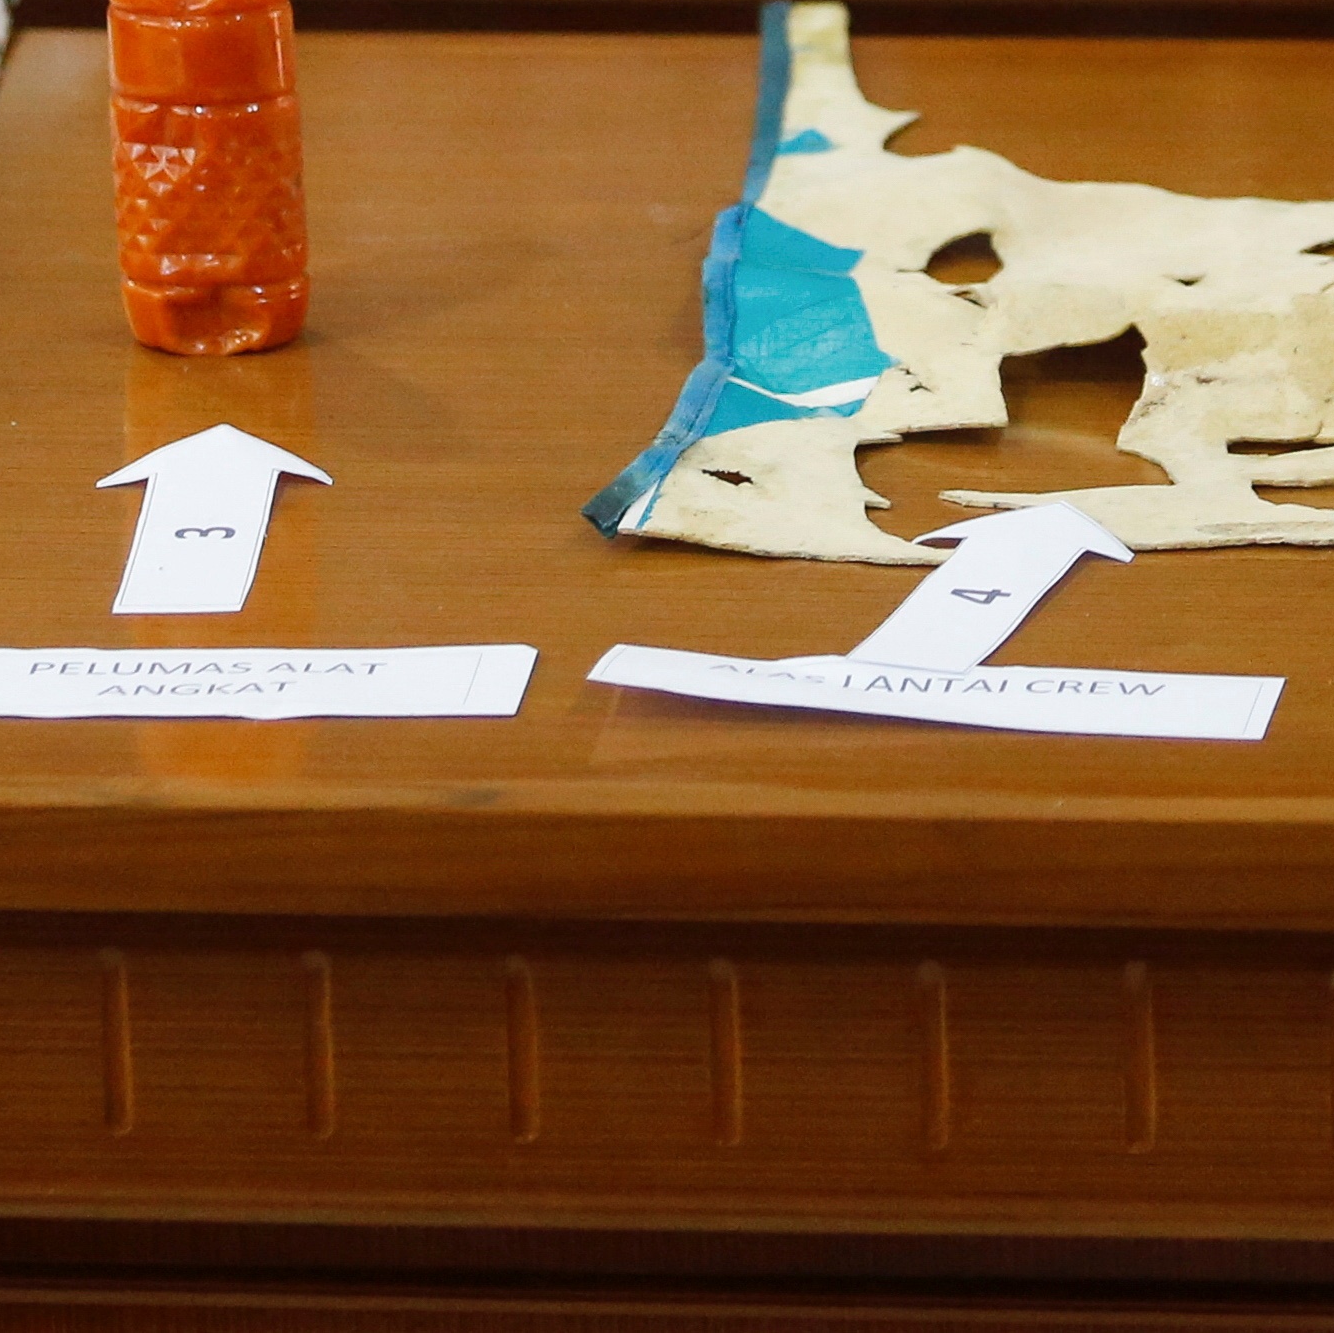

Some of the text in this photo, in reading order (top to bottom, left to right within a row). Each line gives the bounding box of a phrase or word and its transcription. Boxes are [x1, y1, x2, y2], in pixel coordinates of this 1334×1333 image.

[174, 526, 236, 539] 3
[950, 588, 1012, 605] 4
[28, 661, 388, 675] PELUMAS ALAT
[97, 680, 298, 696] ANGKAT
[1025, 678, 1166, 697] CREW
